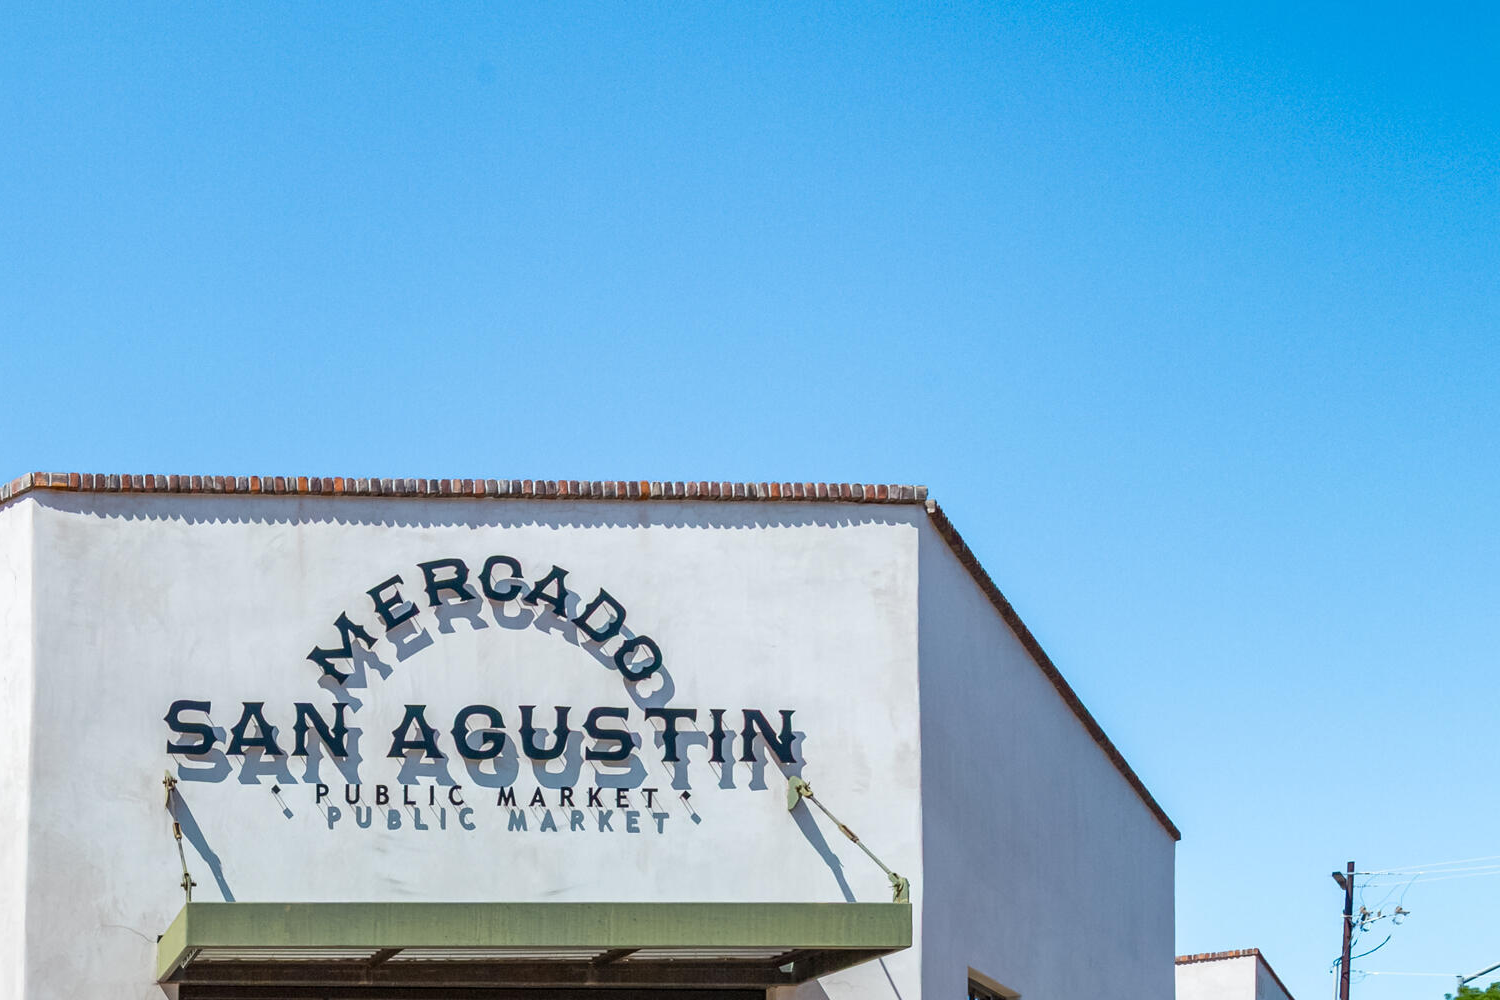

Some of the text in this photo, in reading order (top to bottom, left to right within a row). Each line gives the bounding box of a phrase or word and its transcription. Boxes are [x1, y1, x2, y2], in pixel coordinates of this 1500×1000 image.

[306, 555, 664, 687] MERCADO
[163, 699, 799, 764] SAN AGUSTIN
[315, 783, 659, 809] PUBLIC MARKET
